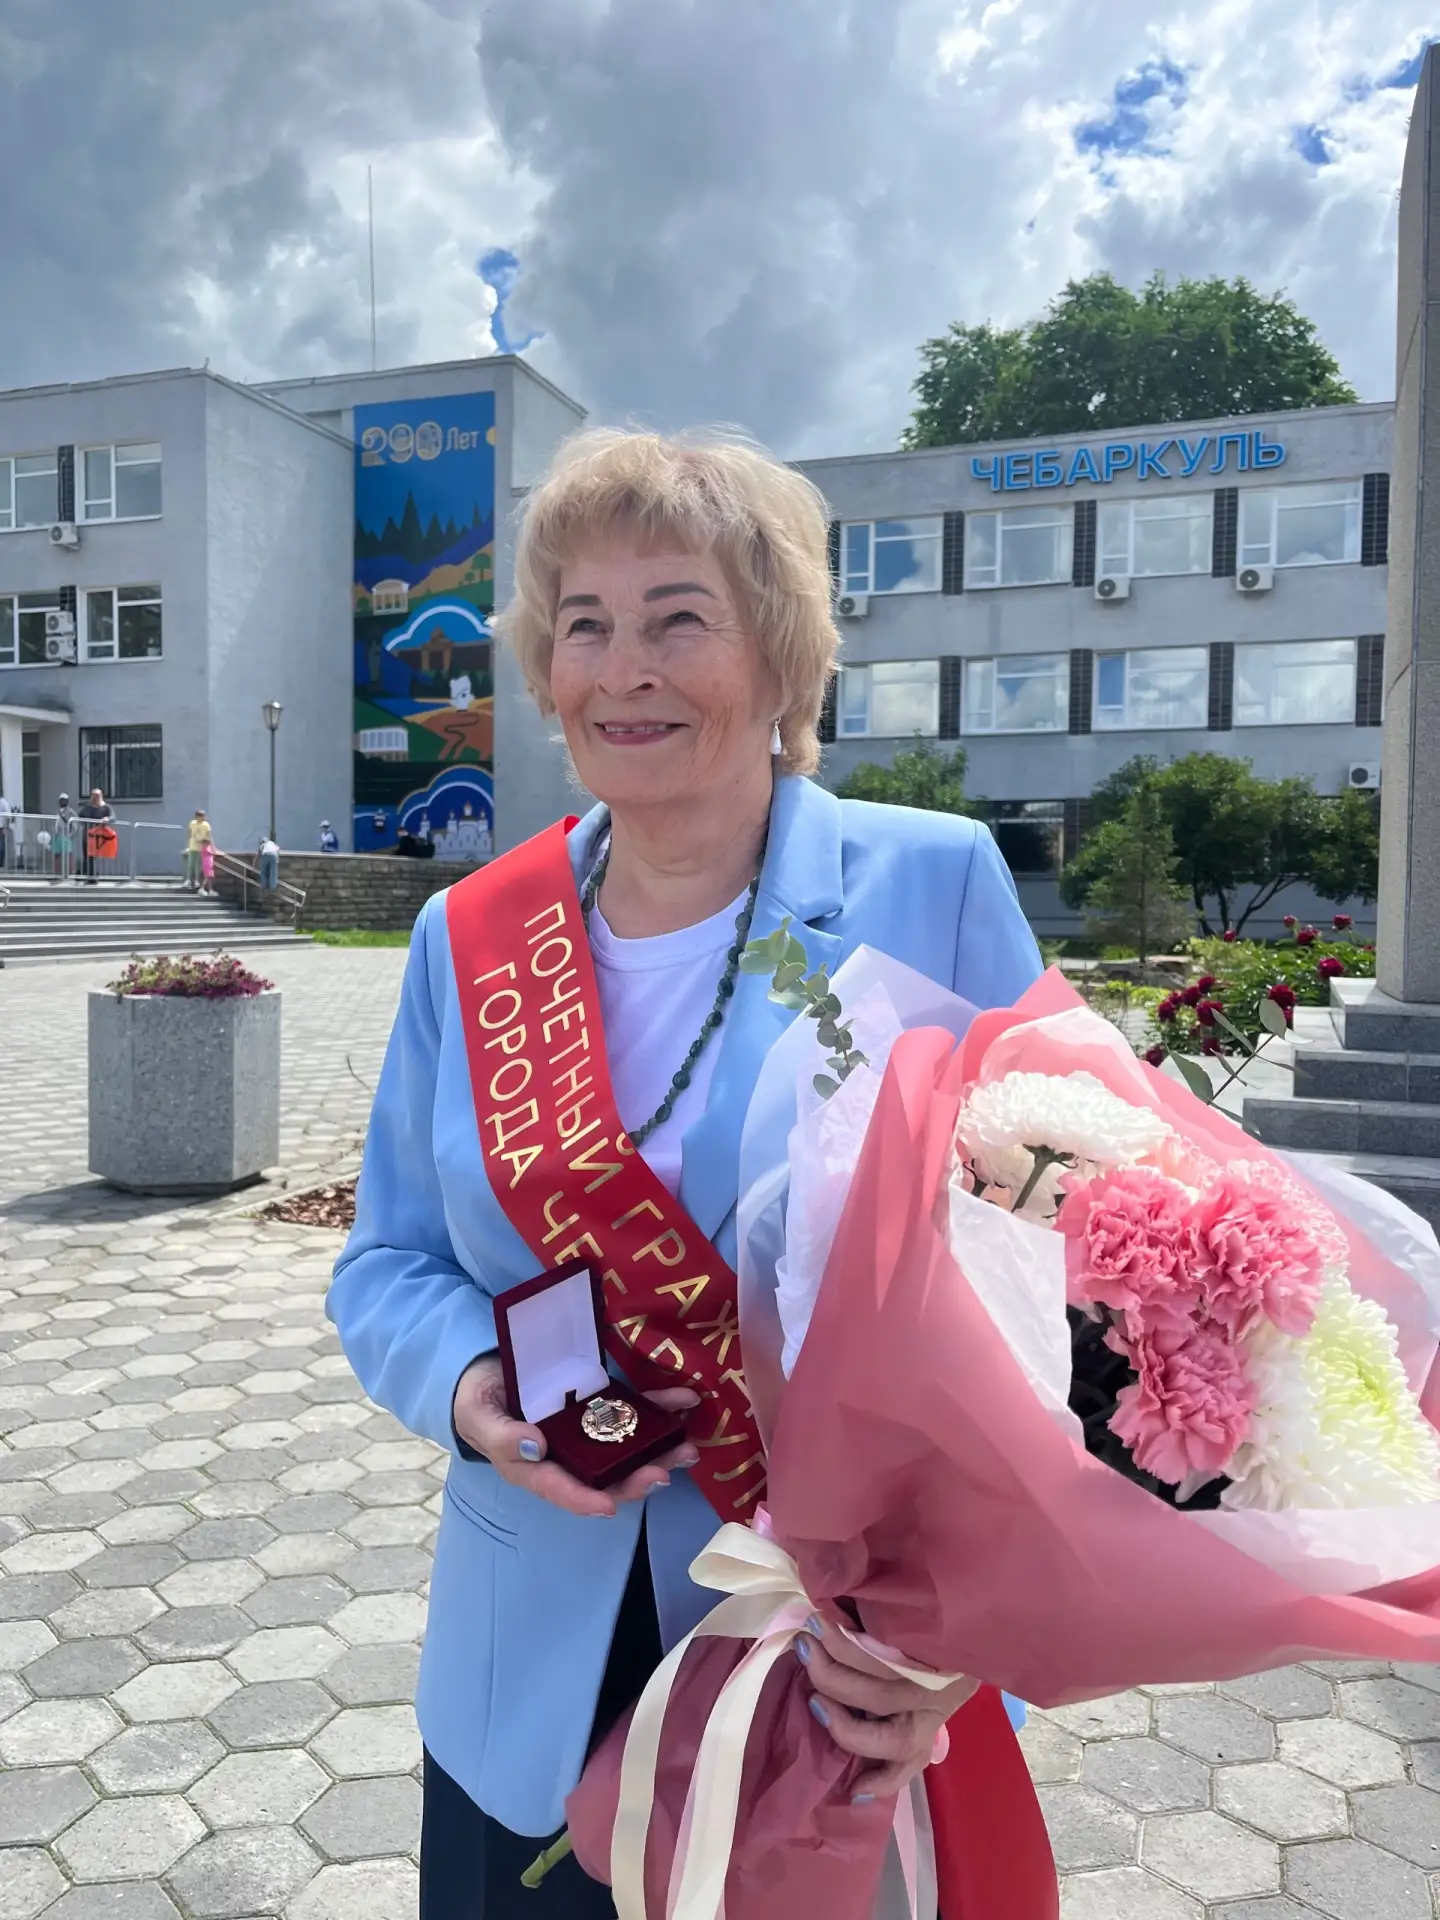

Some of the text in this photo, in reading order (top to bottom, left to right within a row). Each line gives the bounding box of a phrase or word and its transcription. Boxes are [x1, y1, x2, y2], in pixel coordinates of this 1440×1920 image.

[361, 420, 443, 467] 290
[970, 431, 1286, 492] ЧЕБАРКУЛЬ
[473, 961, 544, 1190] ГОРОДА
[523, 901, 635, 1194] ПОЧЕТНЫЙ
